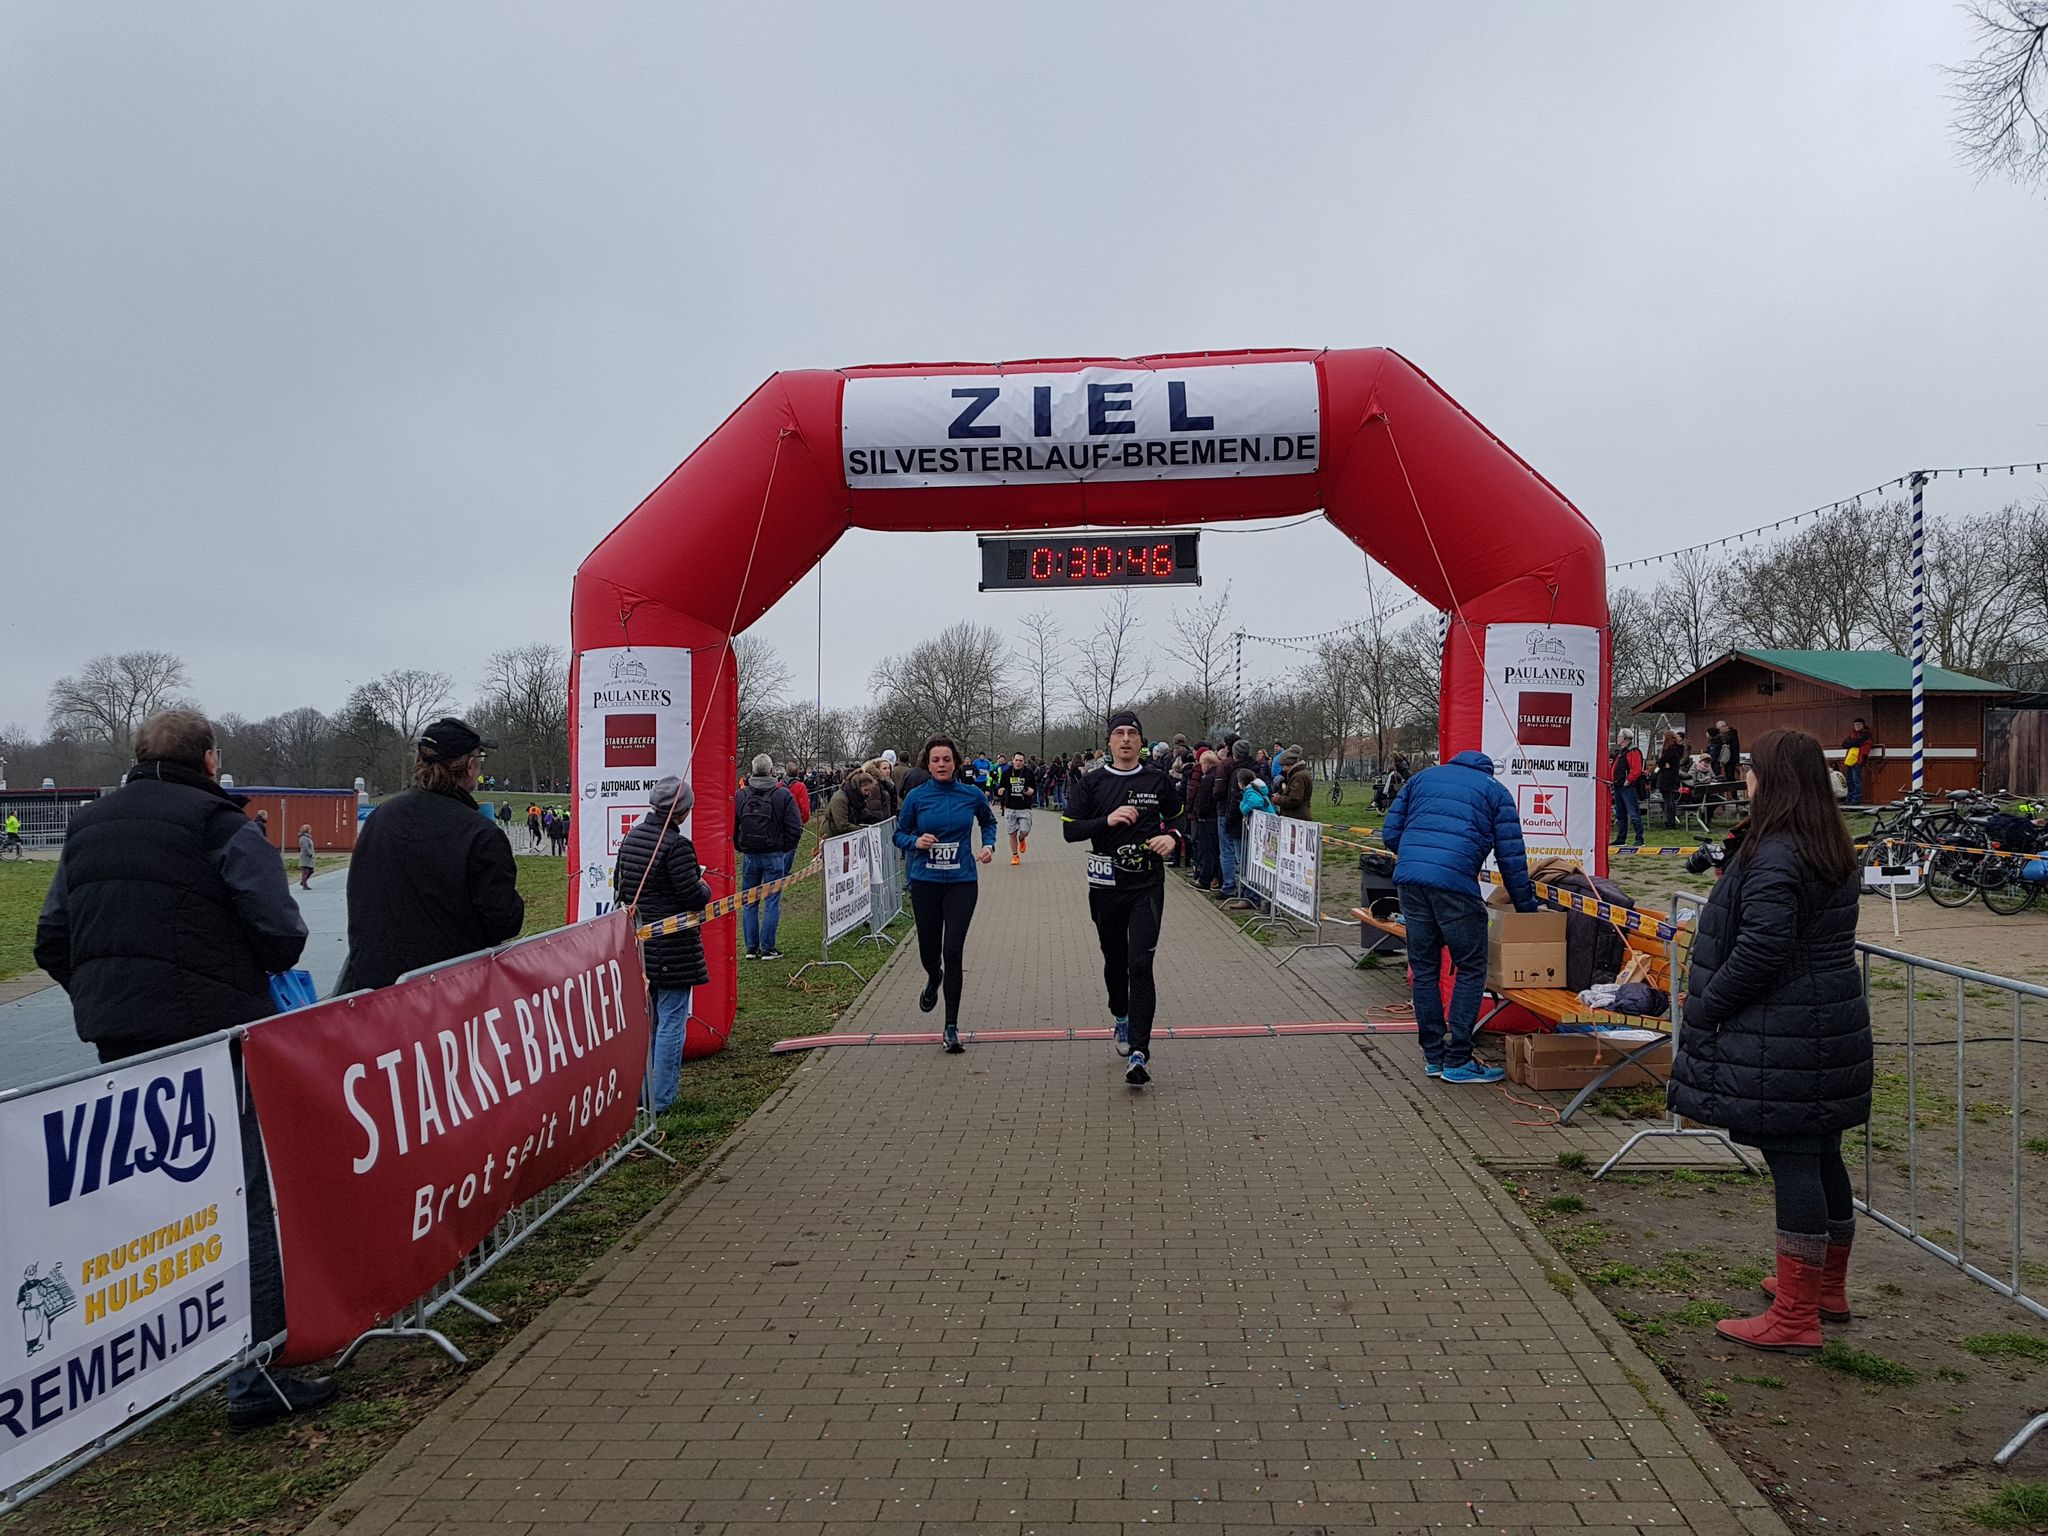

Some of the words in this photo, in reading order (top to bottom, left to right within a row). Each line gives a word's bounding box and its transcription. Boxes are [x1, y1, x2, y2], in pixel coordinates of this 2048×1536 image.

[948, 381, 1214, 439] ZIEL
[849, 435, 1317, 475] SILVESTERLAUF-BREMEN.DE
[1032, 544, 1173, 579] 0:30:46
[1504, 667, 1585, 686] PAULANER'S
[594, 689, 671, 708] PAULANER'S
[1511, 759, 1555, 771] AUTOHAUS
[601, 780, 640, 791] AUTOHAUS
[1522, 818, 1562, 827] Kaufland
[928, 848, 958, 860] 1207
[1088, 859, 1113, 875] 306
[343, 958, 627, 1176] STARKEBÄCKER
[43, 1067, 217, 1208] VILSA
[412, 1152, 496, 1242] Brot
[503, 1112, 558, 1182] seit
[567, 1067, 623, 1137] 1868.
[81, 1203, 219, 1286] FRUCHTHAUS
[84, 1234, 224, 1326] HULSBERG
